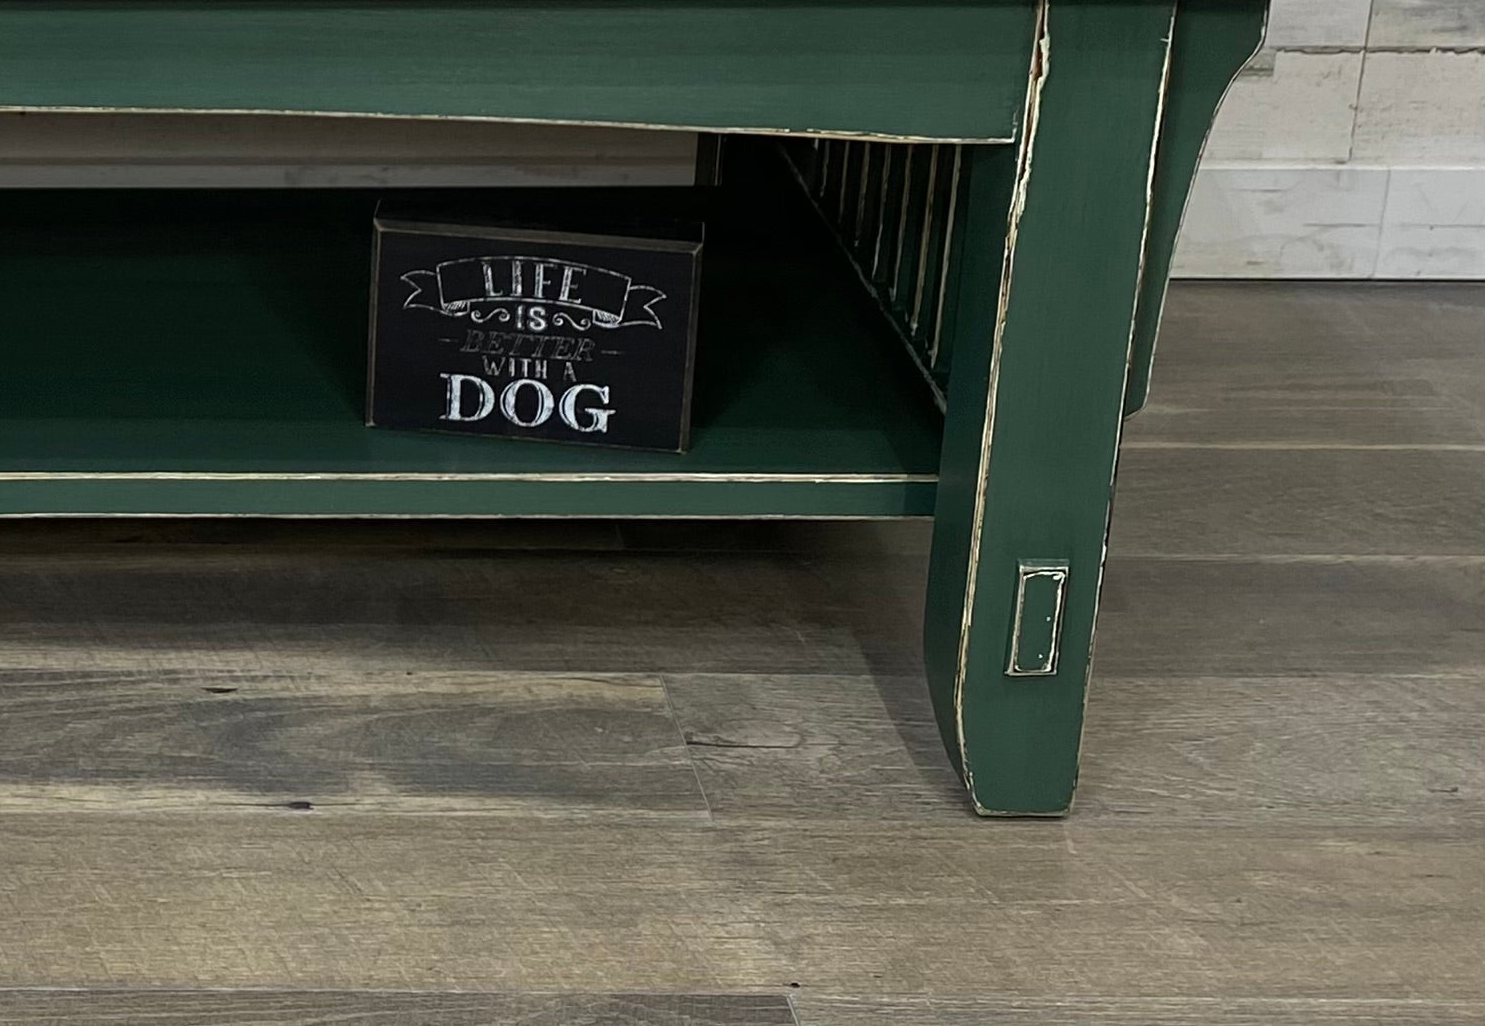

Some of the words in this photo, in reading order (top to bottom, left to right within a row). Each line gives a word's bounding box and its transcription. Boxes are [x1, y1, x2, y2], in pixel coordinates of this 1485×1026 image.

[481, 260, 587, 304] LIFE
[516, 305, 547, 331] IS
[459, 329, 596, 361] BETTER
[482, 356, 547, 379] WITH
[563, 362, 578, 382] A
[439, 373, 616, 433] DOG
